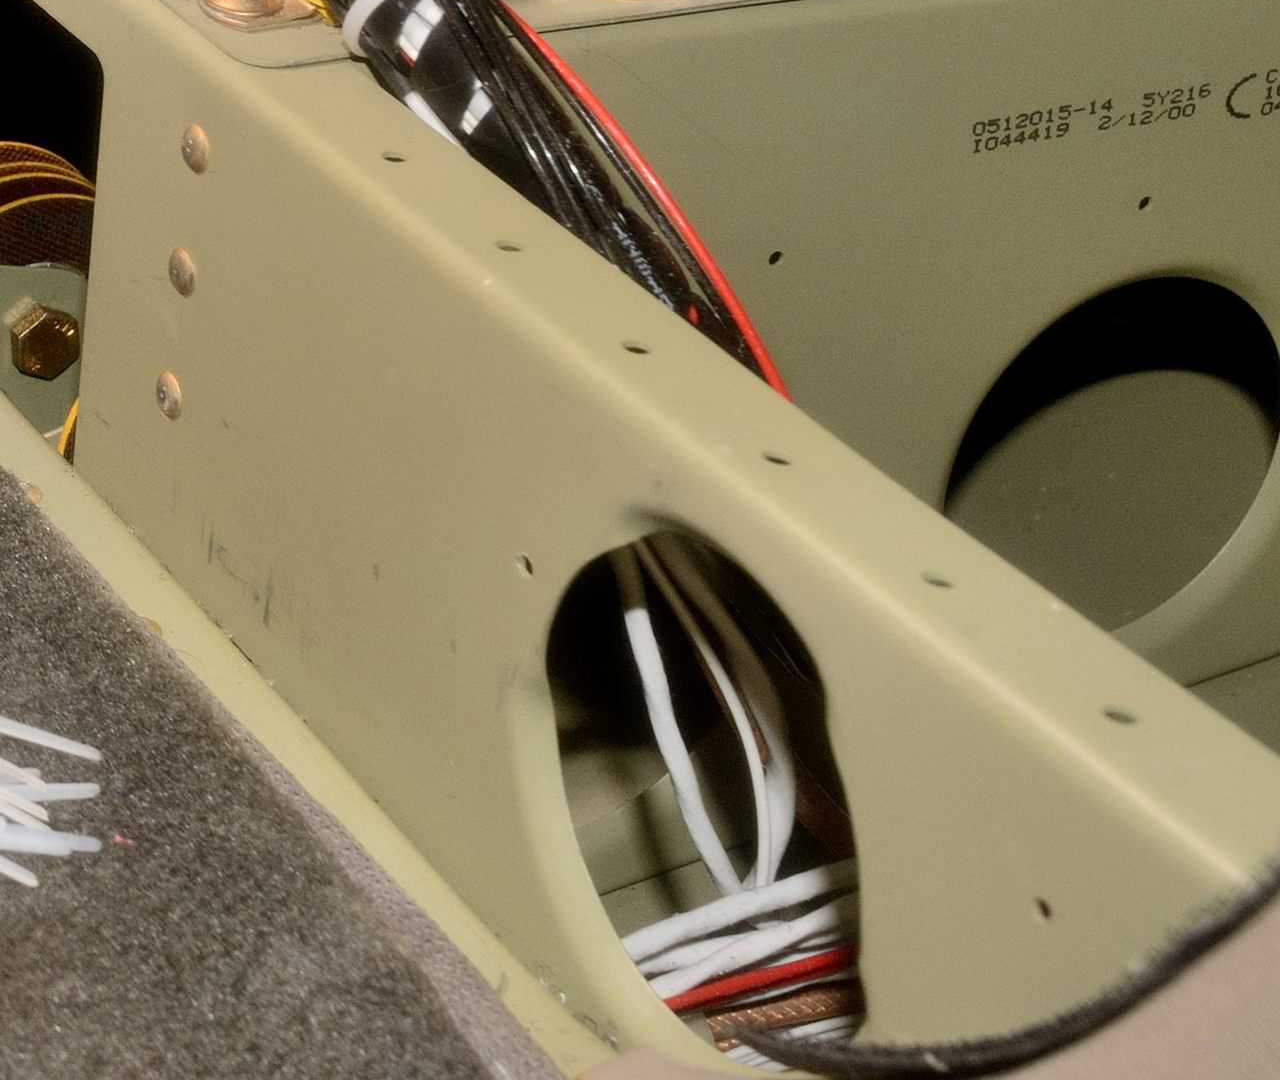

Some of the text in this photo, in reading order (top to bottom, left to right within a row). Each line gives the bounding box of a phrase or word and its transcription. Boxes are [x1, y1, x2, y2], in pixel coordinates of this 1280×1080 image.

[972, 83, 1211, 138] 0512015-14 5Y216
[1097, 103, 1196, 131] 2/12/00
